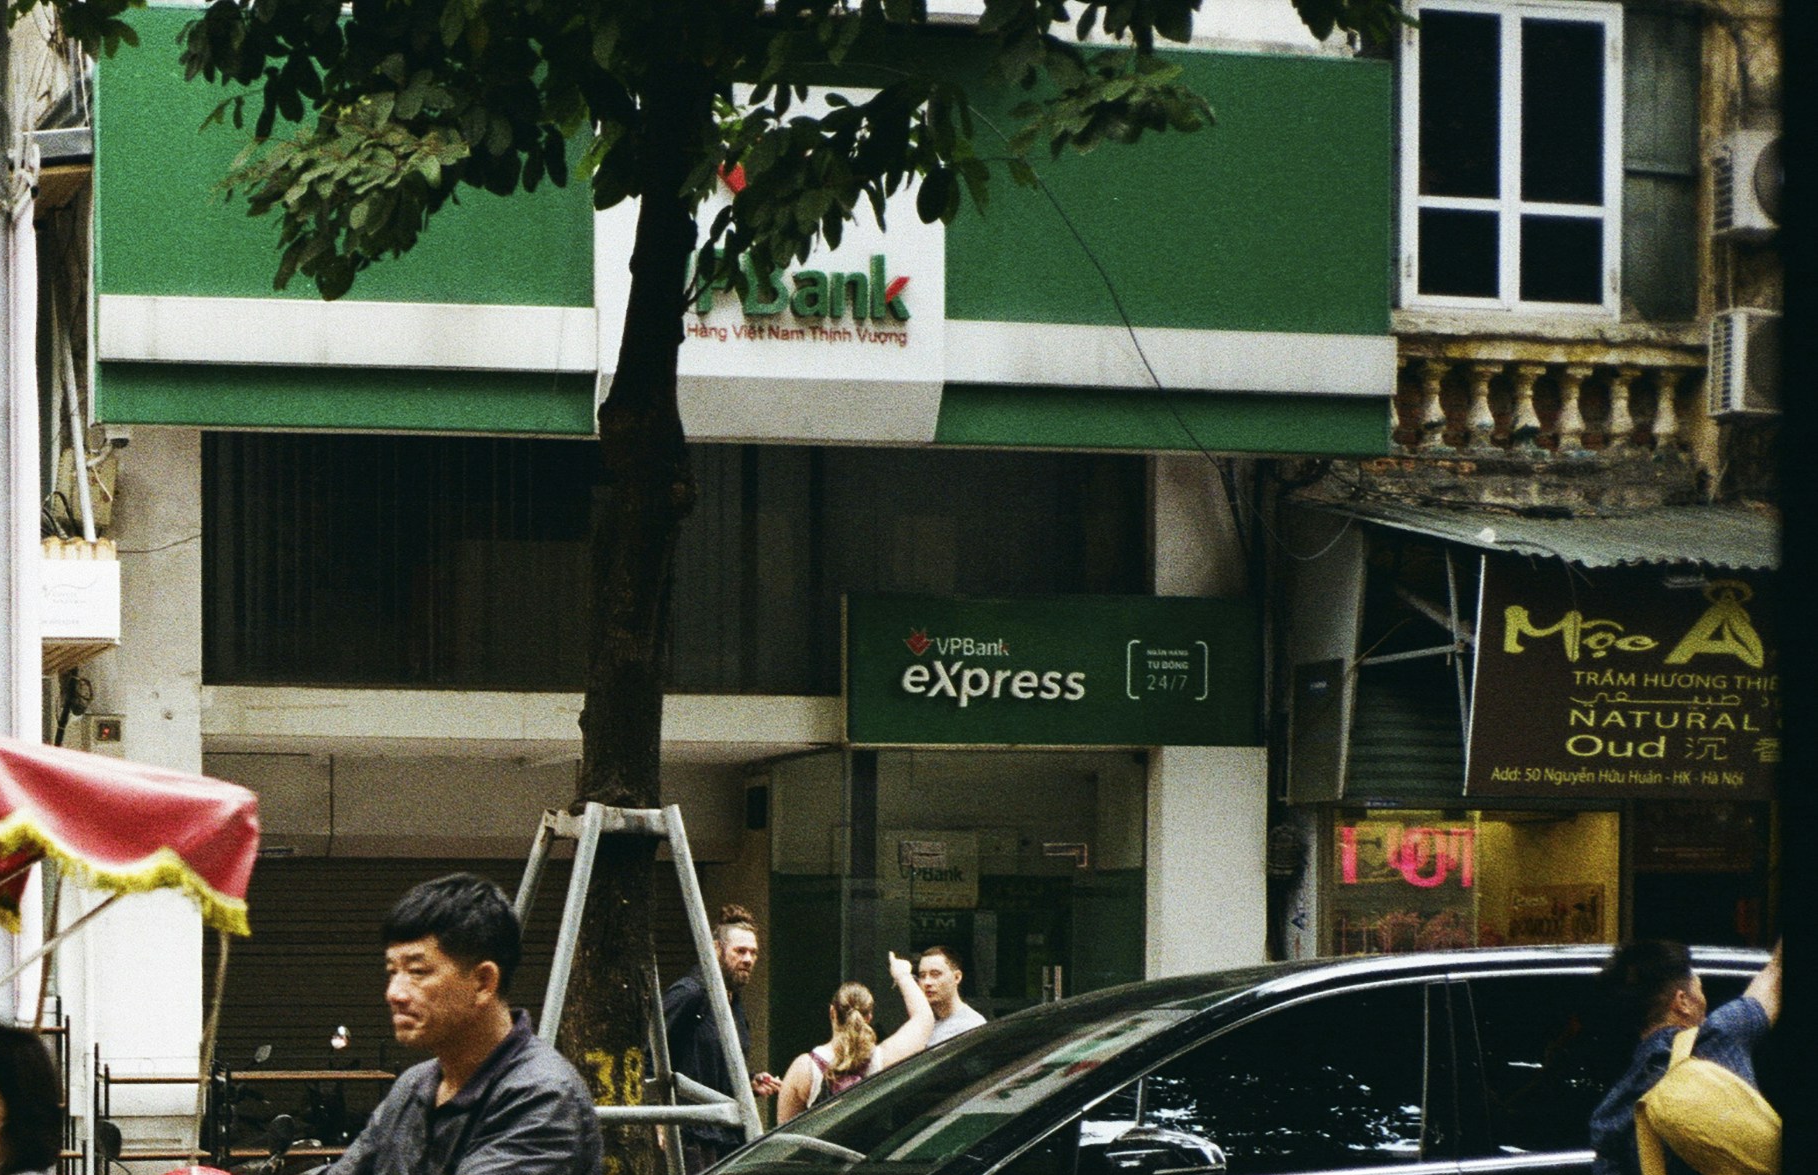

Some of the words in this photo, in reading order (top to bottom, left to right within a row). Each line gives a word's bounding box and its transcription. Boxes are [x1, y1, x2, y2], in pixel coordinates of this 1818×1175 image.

[686, 323, 727, 342] Hàng
[732, 324, 764, 341] Việt
[768, 327, 805, 340] Nam
[808, 325, 852, 343] Thịnh
[856, 327, 908, 347] Vượng
[936, 636, 1010, 656] VPBank
[1146, 674, 1188, 691] 24/7
[1569, 708, 1760, 731] NATURAL
[1565, 733, 1666, 758] Oud
[1491, 767, 1521, 782] Add:
[1525, 768, 1541, 782] 50
[1544, 767, 1595, 785] Nguyễn
